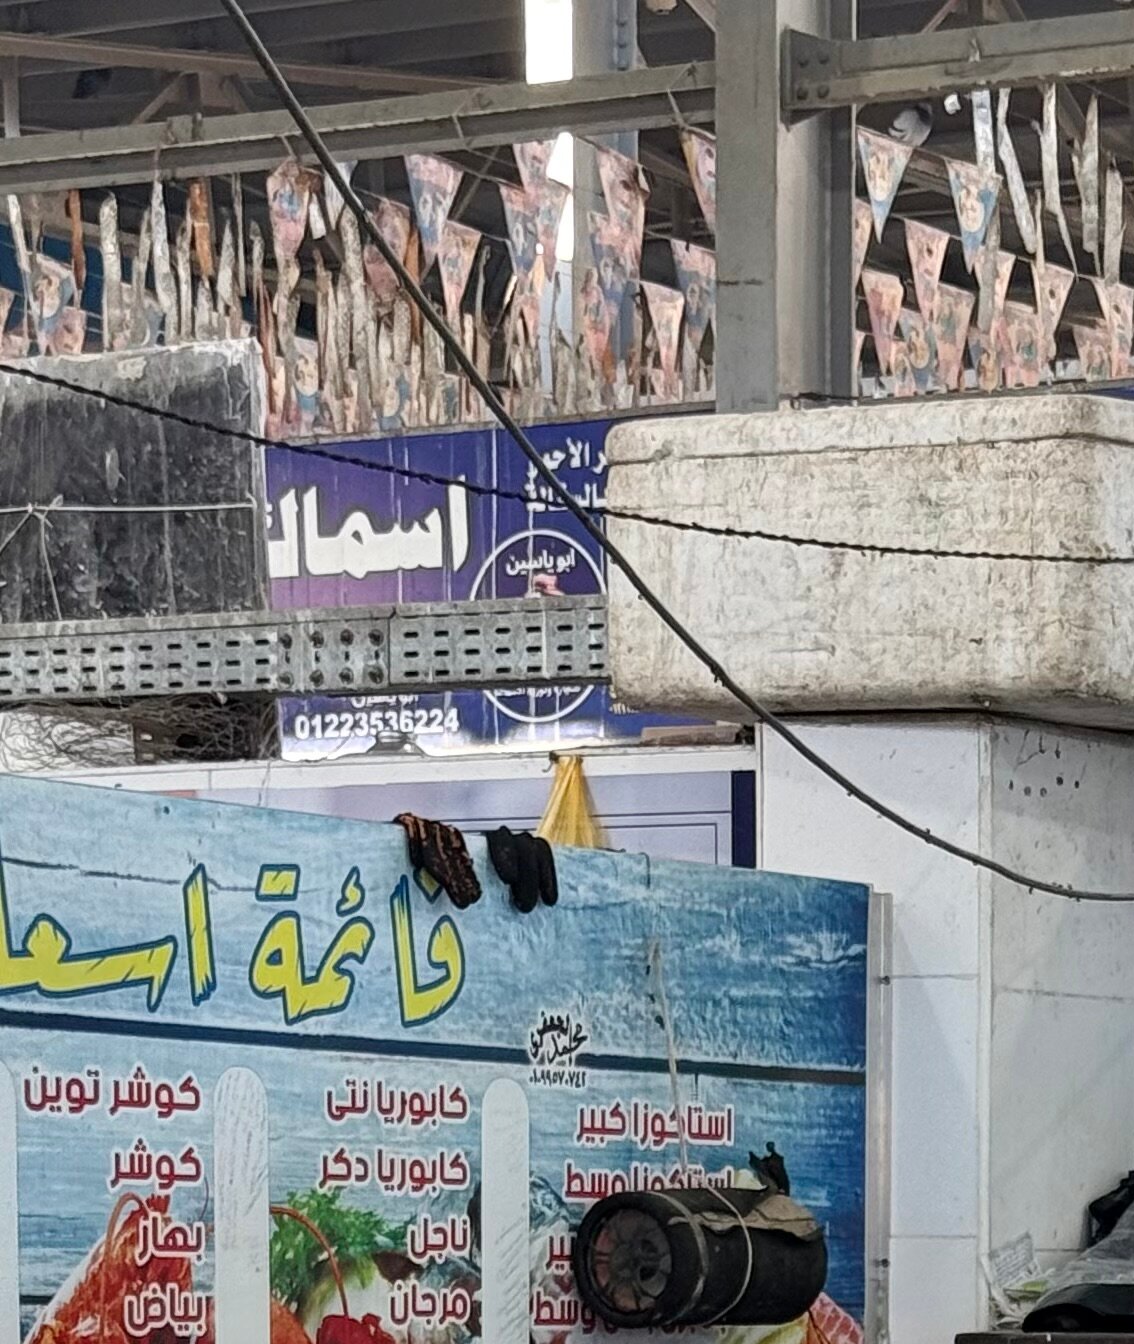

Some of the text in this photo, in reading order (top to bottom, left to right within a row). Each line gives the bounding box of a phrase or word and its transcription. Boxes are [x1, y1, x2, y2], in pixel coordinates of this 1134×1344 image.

[294, 708, 460, 740] 01223536224
[0, 855, 217, 1012] اسع
[109, 1066, 202, 1119] كوشر
[376, 1080, 469, 1126] كابوريا
[576, 1101, 627, 1144] كبير
[110, 1138, 203, 1189] كوشر
[318, 1147, 469, 1195] كابوريا دكر
[409, 1217, 470, 1261] ناجل
[125, 1284, 206, 1333] بياض
[390, 1282, 470, 1325] مرجان
